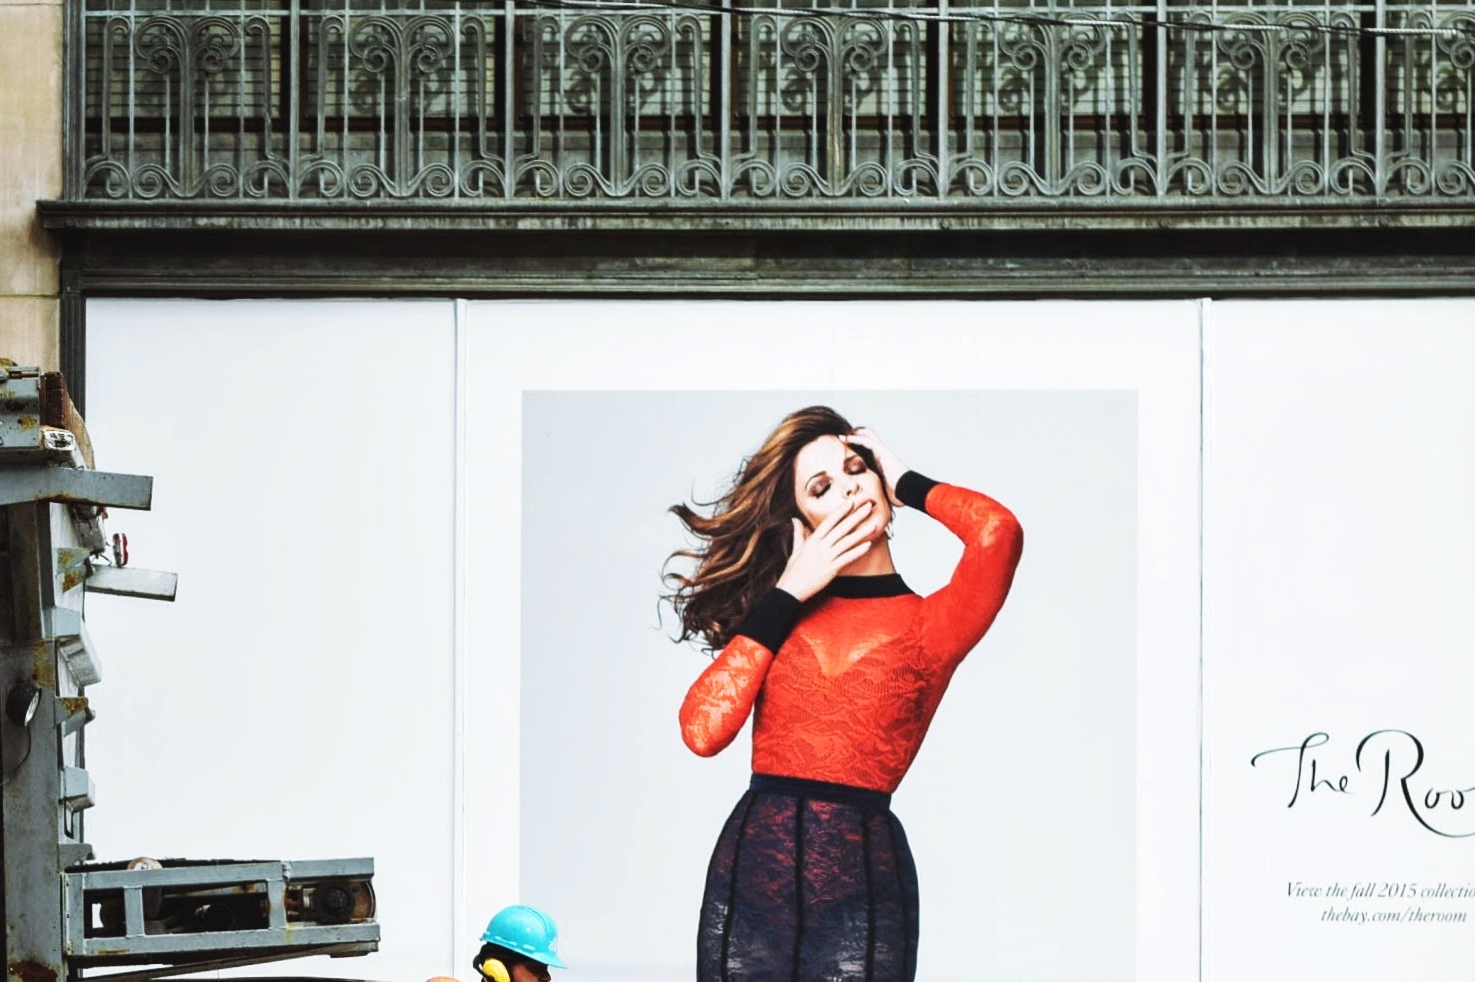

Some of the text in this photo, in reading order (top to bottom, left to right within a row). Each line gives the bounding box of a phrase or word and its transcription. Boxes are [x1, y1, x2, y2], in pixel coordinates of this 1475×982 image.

[1250, 731, 1350, 808] The
[1287, 881, 1322, 898] View
[1325, 881, 1348, 898] the
[1345, 881, 1377, 902] fall
[1377, 882, 1418, 898] 2015
[1321, 906, 1467, 925] thebay.com/theroom
